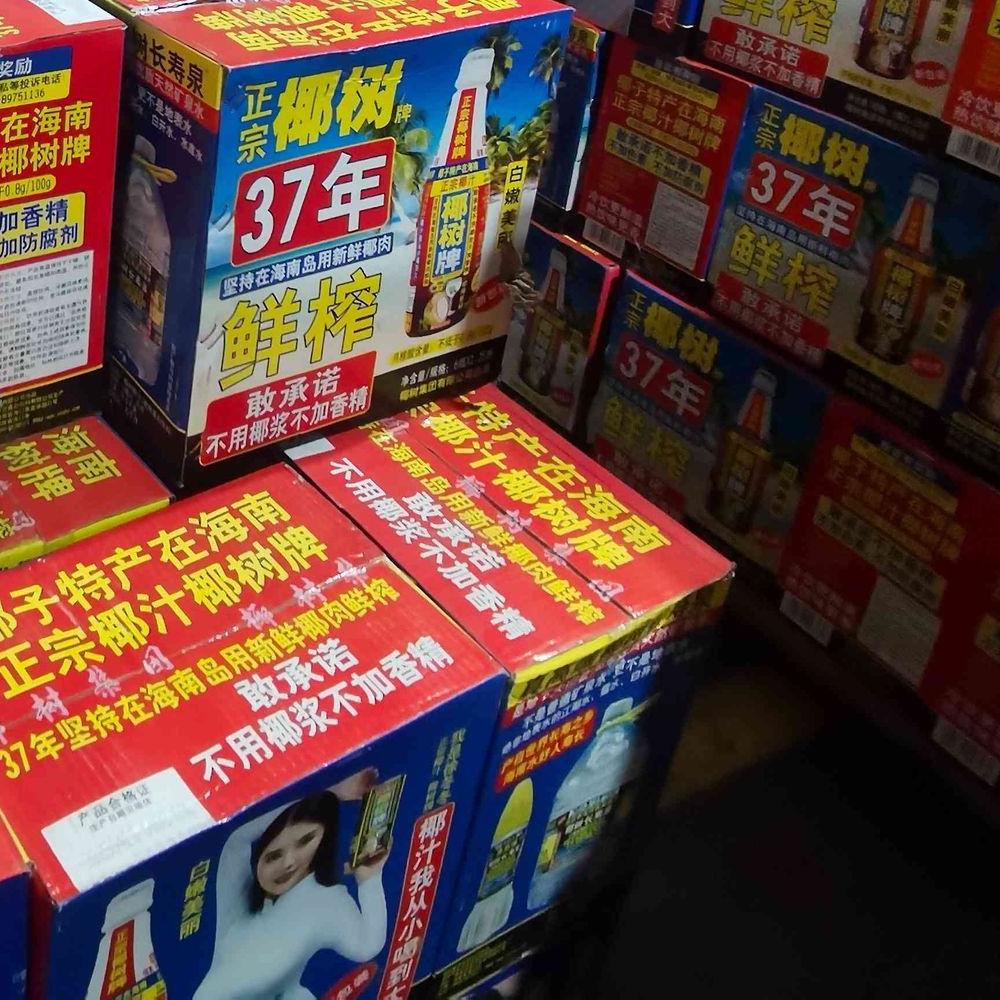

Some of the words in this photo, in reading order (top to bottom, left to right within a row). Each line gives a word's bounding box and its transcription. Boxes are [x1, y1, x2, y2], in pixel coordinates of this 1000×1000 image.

[735, 28, 801, 66] 敢承诺
[236, 83, 273, 164] 正宗
[754, 101, 782, 148] 正宗
[240, 152, 387, 253] 37年
[434, 192, 469, 273] 椰树牌
[748, 159, 863, 250] 37年
[221, 235, 393, 298] 坚持在海南岛用新鲜椰肉
[727, 223, 840, 318] 鲜榨
[219, 269, 381, 390] 鲜榨
[246, 366, 342, 420] 敢承诺
[616, 338, 712, 420] 37年
[206, 384, 369, 459] 不用椰浆不加香精
[328, 456, 540, 642] 不用椰浆不加香精
[402, 493, 508, 574] 敢承诺
[190, 635, 456, 787] 不用椰浆不加香精
[233, 637, 359, 714] 敢承诺
